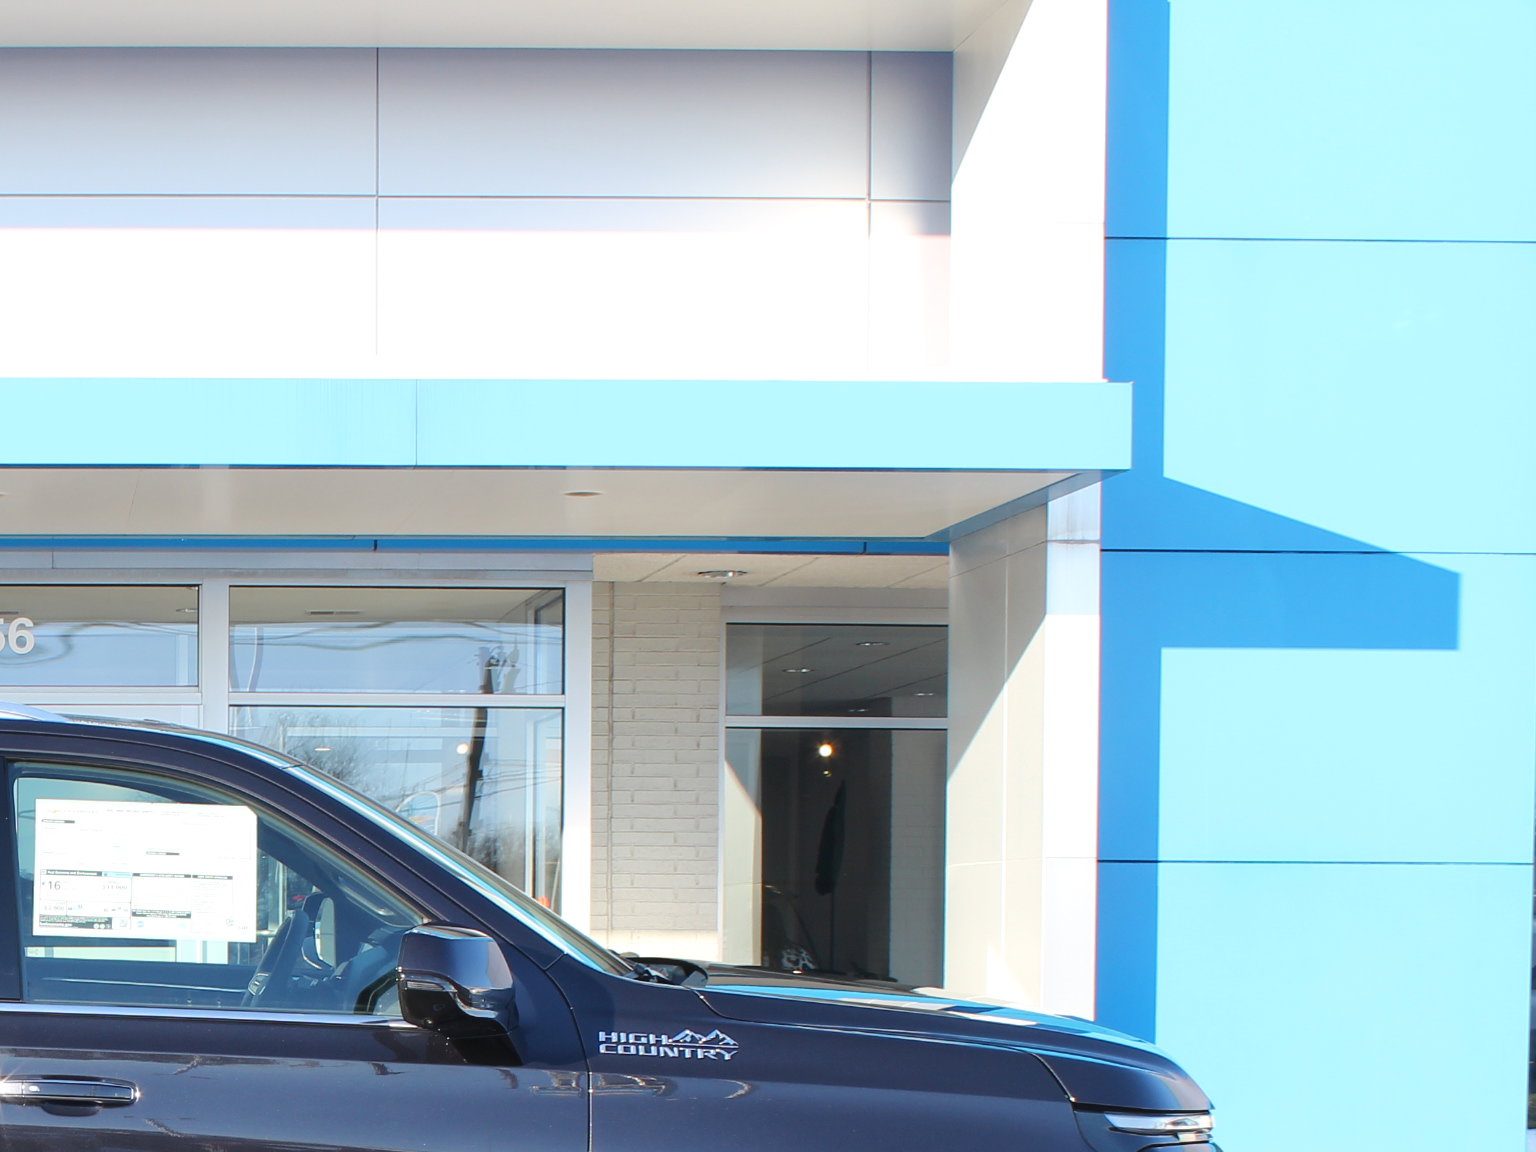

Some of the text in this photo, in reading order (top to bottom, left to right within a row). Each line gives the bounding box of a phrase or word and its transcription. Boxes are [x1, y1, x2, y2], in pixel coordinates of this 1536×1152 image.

[48, 880, 61, 891] 16
[598, 1031, 670, 1045] HIGH
[599, 1043, 738, 1060] COUNTRY
